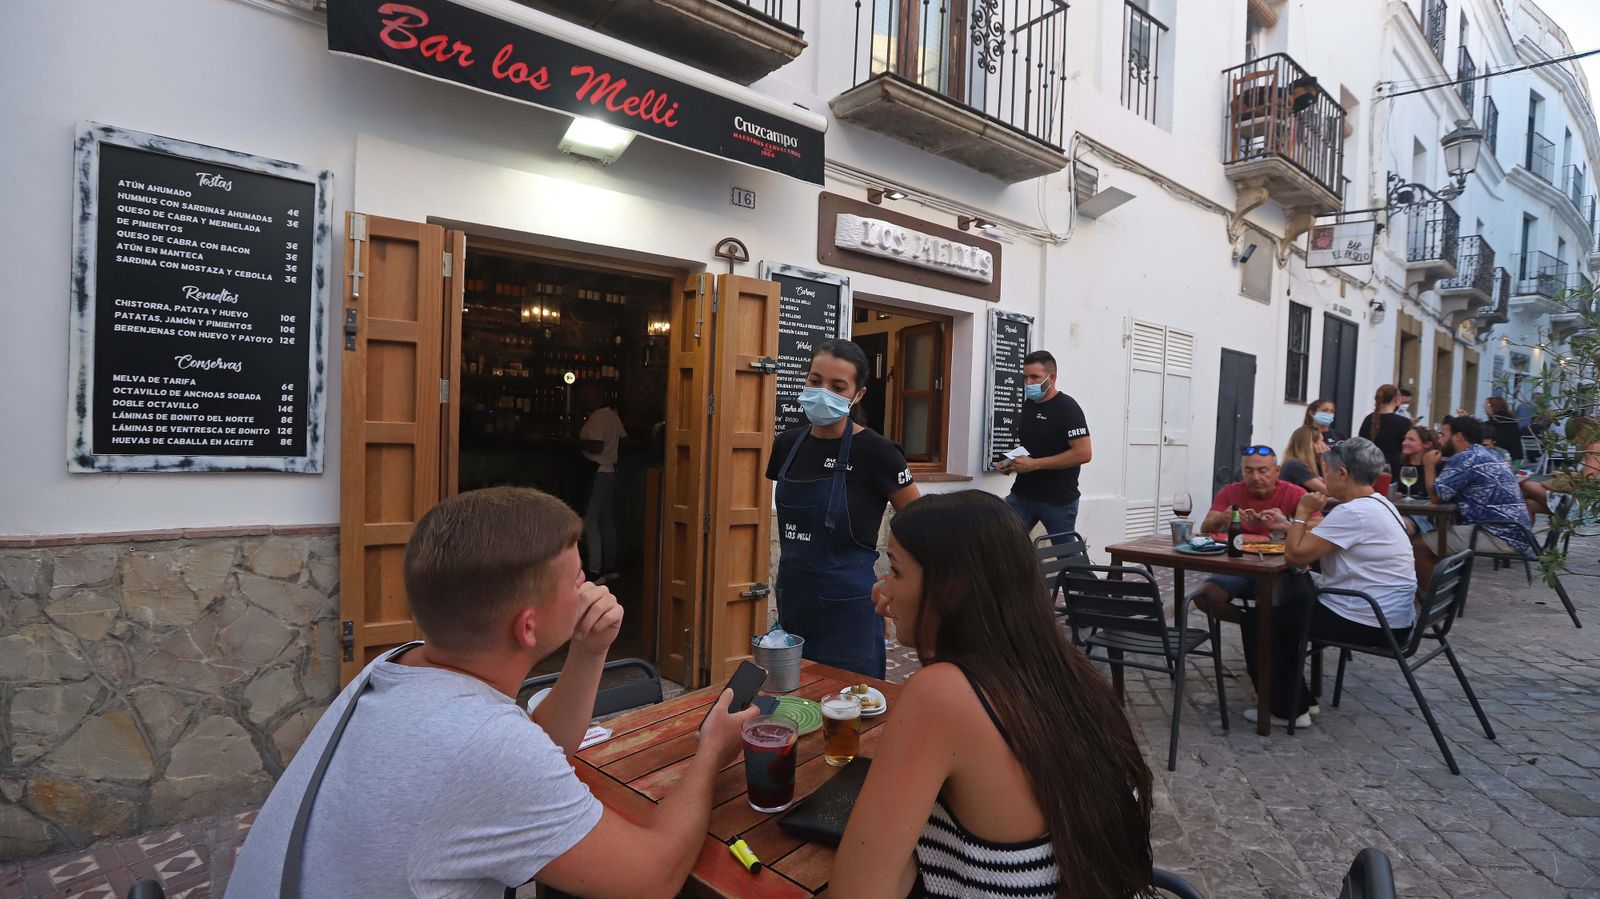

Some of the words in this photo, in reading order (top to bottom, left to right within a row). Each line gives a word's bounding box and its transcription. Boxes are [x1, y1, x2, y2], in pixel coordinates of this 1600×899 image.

[376, 2, 477, 69] Bar
[492, 43, 551, 91] los
[570, 64, 679, 128] Melli
[734, 116, 798, 148] Cruzcampo
[732, 131, 764, 147] MAESTROS
[765, 143, 801, 158] CERVECEROS
[195, 172, 232, 192] Tostas
[118, 179, 145, 190] ATÚN
[147, 184, 192, 198] AHUMADO
[738, 190, 752, 205] 16
[117, 192, 158, 205] HUMMUS
[160, 199, 179, 208] CON
[181, 202, 225, 215] SARDINAS
[227, 210, 273, 223] AHUMADAS
[287, 209, 300, 217] 4€
[116, 217, 130, 225] DE
[132, 219, 183, 233] PIMIENTOS
[117, 205, 150, 216] QUESO
[153, 210, 165, 218] DE
[167, 212, 198, 223] CABRA
[209, 219, 260, 233] MERMELADA
[286, 220, 299, 228] 3€
[116, 230, 150, 240] QUESO
[151, 234, 164, 242] DE
[166, 237, 198, 247] CABRA
[200, 241, 219, 250] CON
[220, 244, 250, 254] BACON
[286, 242, 298, 250] 3€
[116, 242, 143, 252] ATÚN
[145, 246, 158, 254] EN
[160, 248, 204, 260] MANTECA
[285, 253, 298, 261] 3€
[116, 255, 157, 267] SARDINA
[159, 260, 179, 269] CON
[181, 263, 225, 275] MOSTAZA
[234, 270, 272, 281] CEBOLLA
[285, 264, 297, 272] 3€
[284, 275, 297, 283] 3€
[182, 285, 239, 304] Revueltos
[174, 305, 209, 315] PATATA
[211, 308, 217, 316] Y
[219, 309, 249, 318] HUEVO
[165, 316, 195, 325] JAMÓN
[206, 320, 252, 331] PIMIENTOS
[280, 314, 296, 323] 10€
[114, 324, 175, 335] BERENJENAS
[177, 329, 196, 338] CON
[198, 331, 229, 340] HUEVO
[238, 334, 273, 344] PAYOYO
[280, 325, 295, 334] 10€
[279, 336, 295, 345] 12€
[174, 354, 242, 373] Conservas
[112, 374, 146, 383] MELVA
[148, 376, 160, 384] DE
[163, 377, 196, 386] TARIFA
[281, 383, 294, 391] 6€
[112, 386, 167, 396] OCTAVILLO
[169, 389, 181, 397] DE
[183, 390, 225, 399] ANCHOAS
[227, 392, 261, 401] SOBADA
[281, 394, 294, 402] 8€
[112, 399, 145, 407] DOBLE
[147, 401, 199, 409] OCTAVILLO
[278, 405, 293, 413] 14€
[112, 411, 154, 420] LÁMINAS
[170, 413, 205, 422] BONITO
[280, 416, 293, 424] 8€
[112, 423, 153, 432] LÁMINAS
[170, 425, 223, 434] VENTRESCA
[238, 427, 270, 435] BONITO
[277, 427, 293, 435] 12€
[1067, 427, 1087, 438] CREW
[112, 436, 151, 444] HUEVAS
[152, 437, 165, 445] DE
[280, 438, 293, 446] 8€
